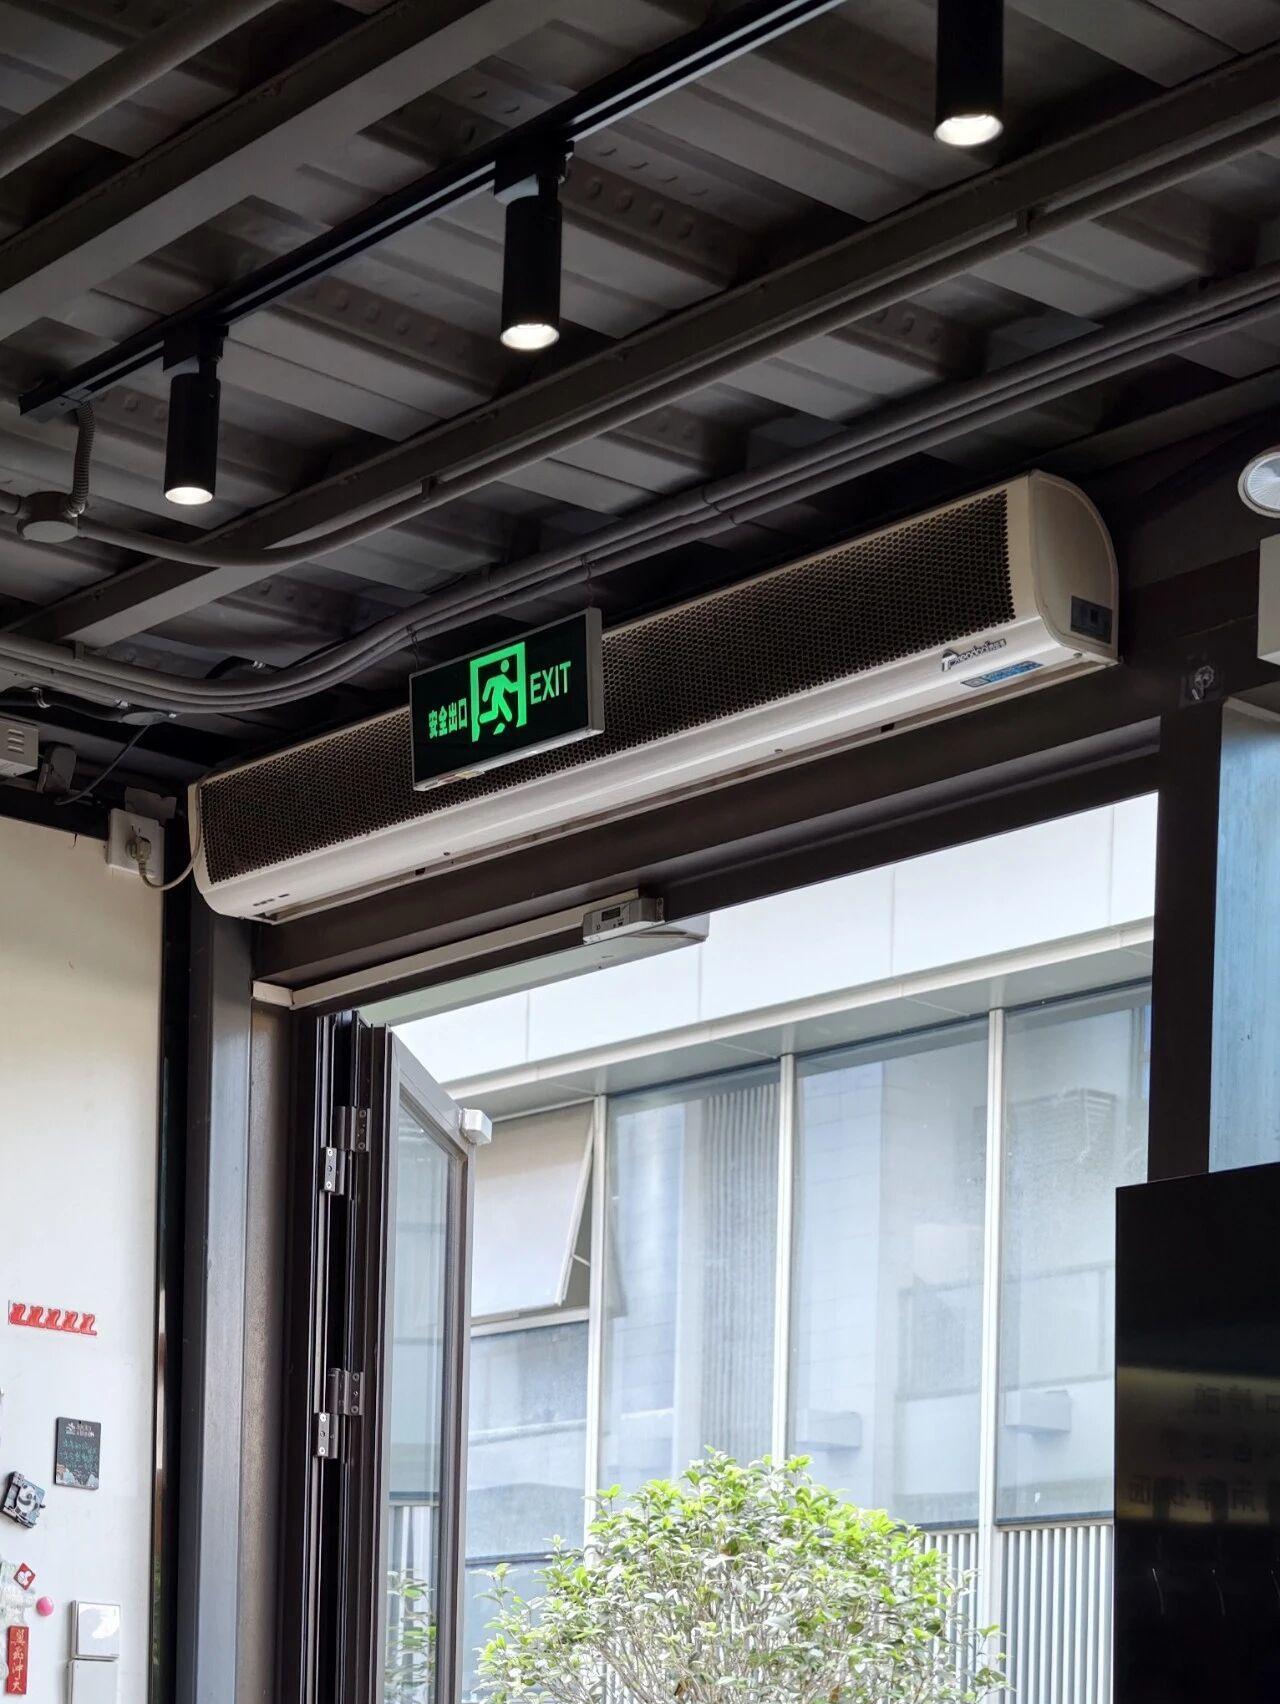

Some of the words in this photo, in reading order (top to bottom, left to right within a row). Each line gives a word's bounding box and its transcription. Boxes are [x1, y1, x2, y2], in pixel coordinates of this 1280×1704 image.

[530, 661, 572, 705] EXIT
[428, 698, 468, 739] 安全出口
